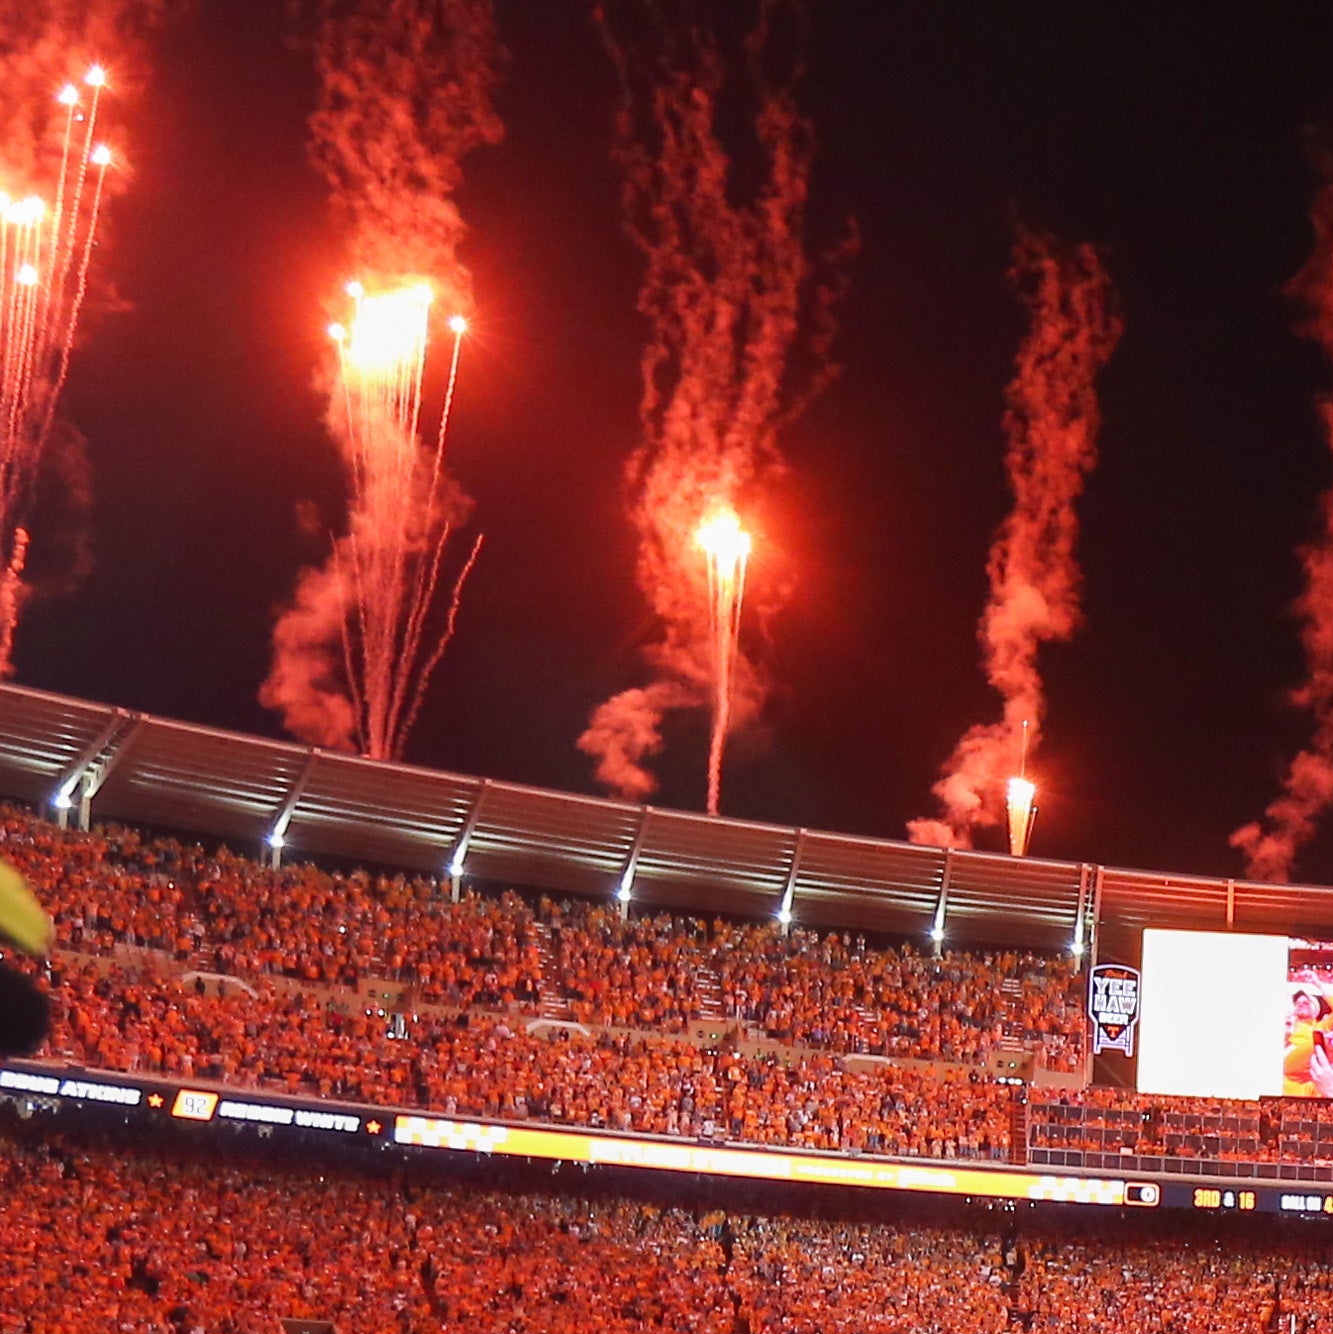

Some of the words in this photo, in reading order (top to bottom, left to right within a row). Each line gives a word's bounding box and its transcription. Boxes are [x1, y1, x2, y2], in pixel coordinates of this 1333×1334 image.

[1094, 976, 1136, 997] YEE
[1093, 994, 1136, 1014] HAW
[1099, 1012, 1129, 1025] BEER
[184, 1096, 208, 1115] 92
[1194, 1189, 1220, 1208] 3RD
[1238, 1192, 1255, 1210] 16
